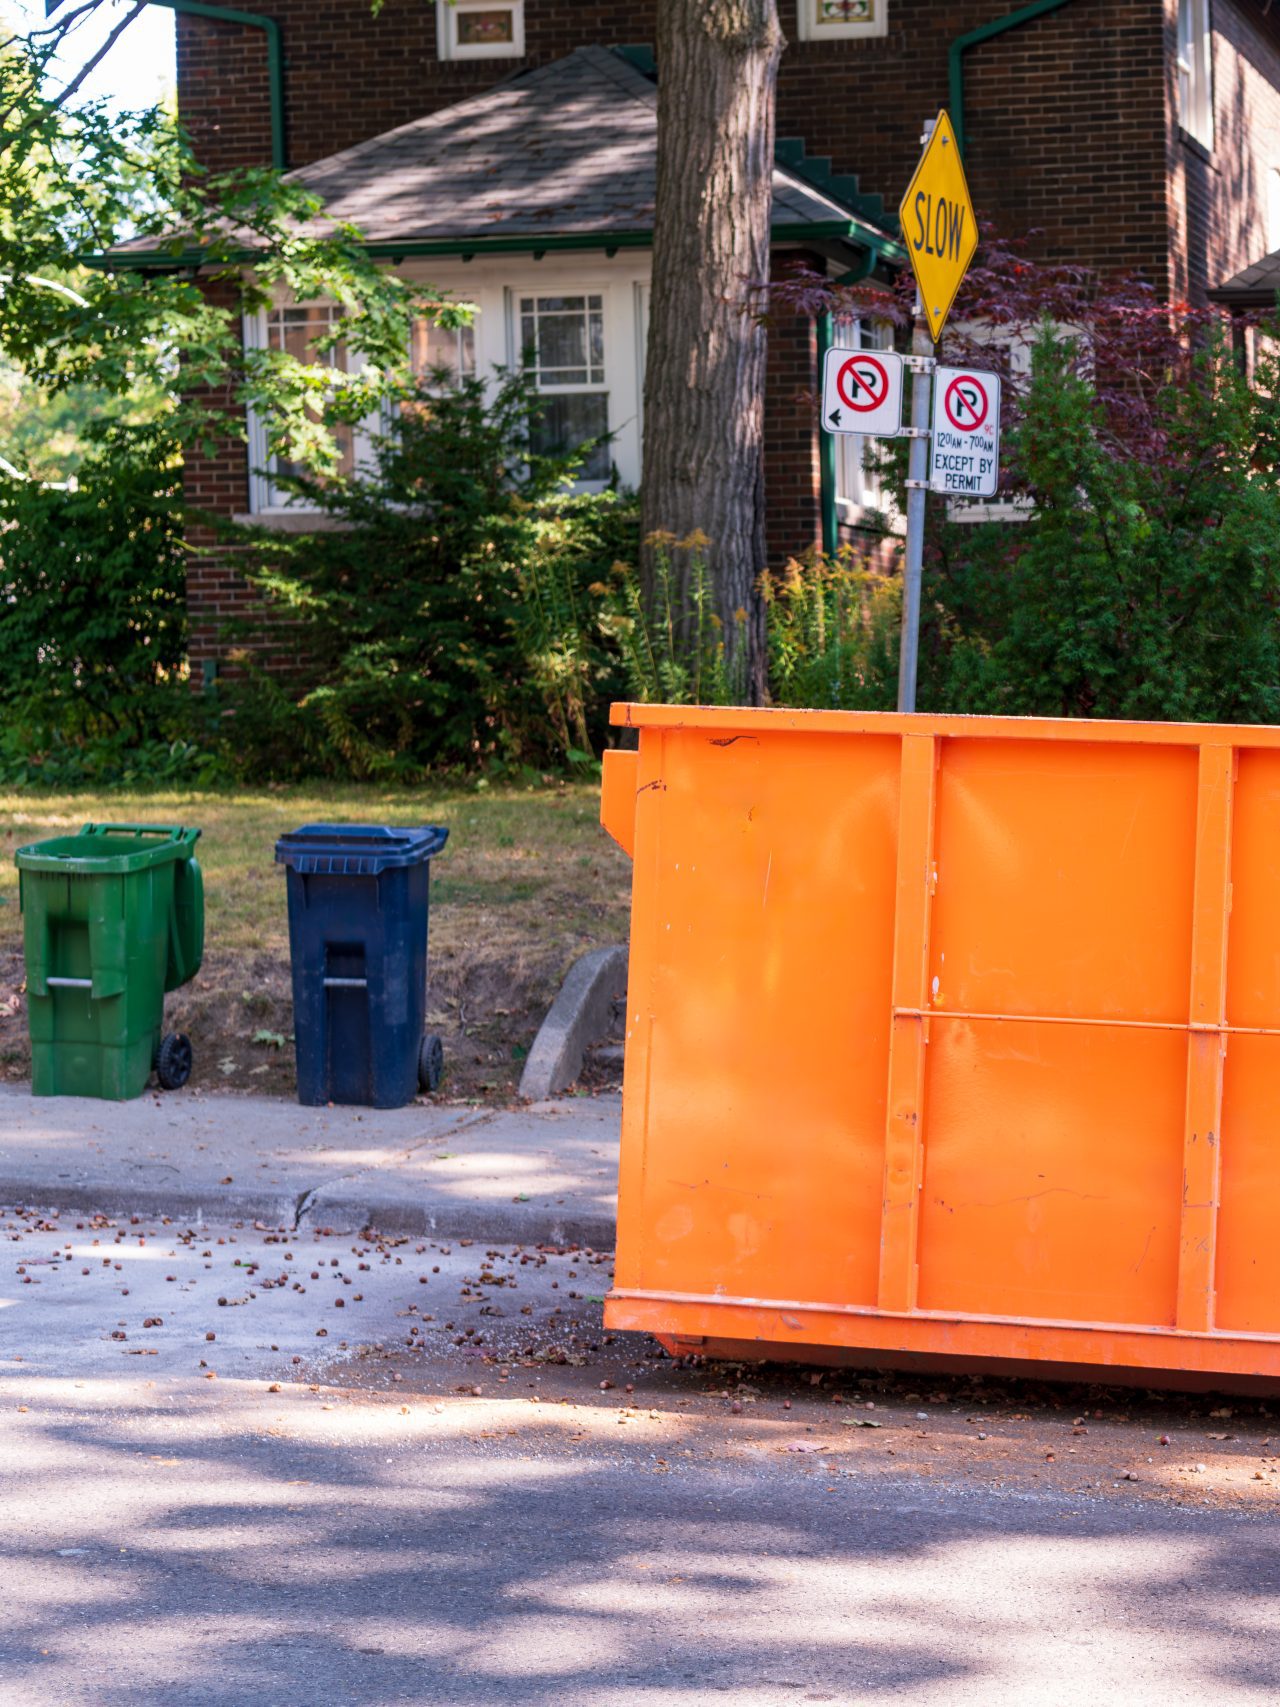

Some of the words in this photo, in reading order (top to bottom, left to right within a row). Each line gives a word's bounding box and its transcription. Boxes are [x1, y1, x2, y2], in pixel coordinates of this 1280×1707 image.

[914, 191, 965, 263] SLOW
[935, 453, 974, 472] EXCEPT
[980, 458, 993, 474] BY
[945, 474, 982, 491] PERMIT
